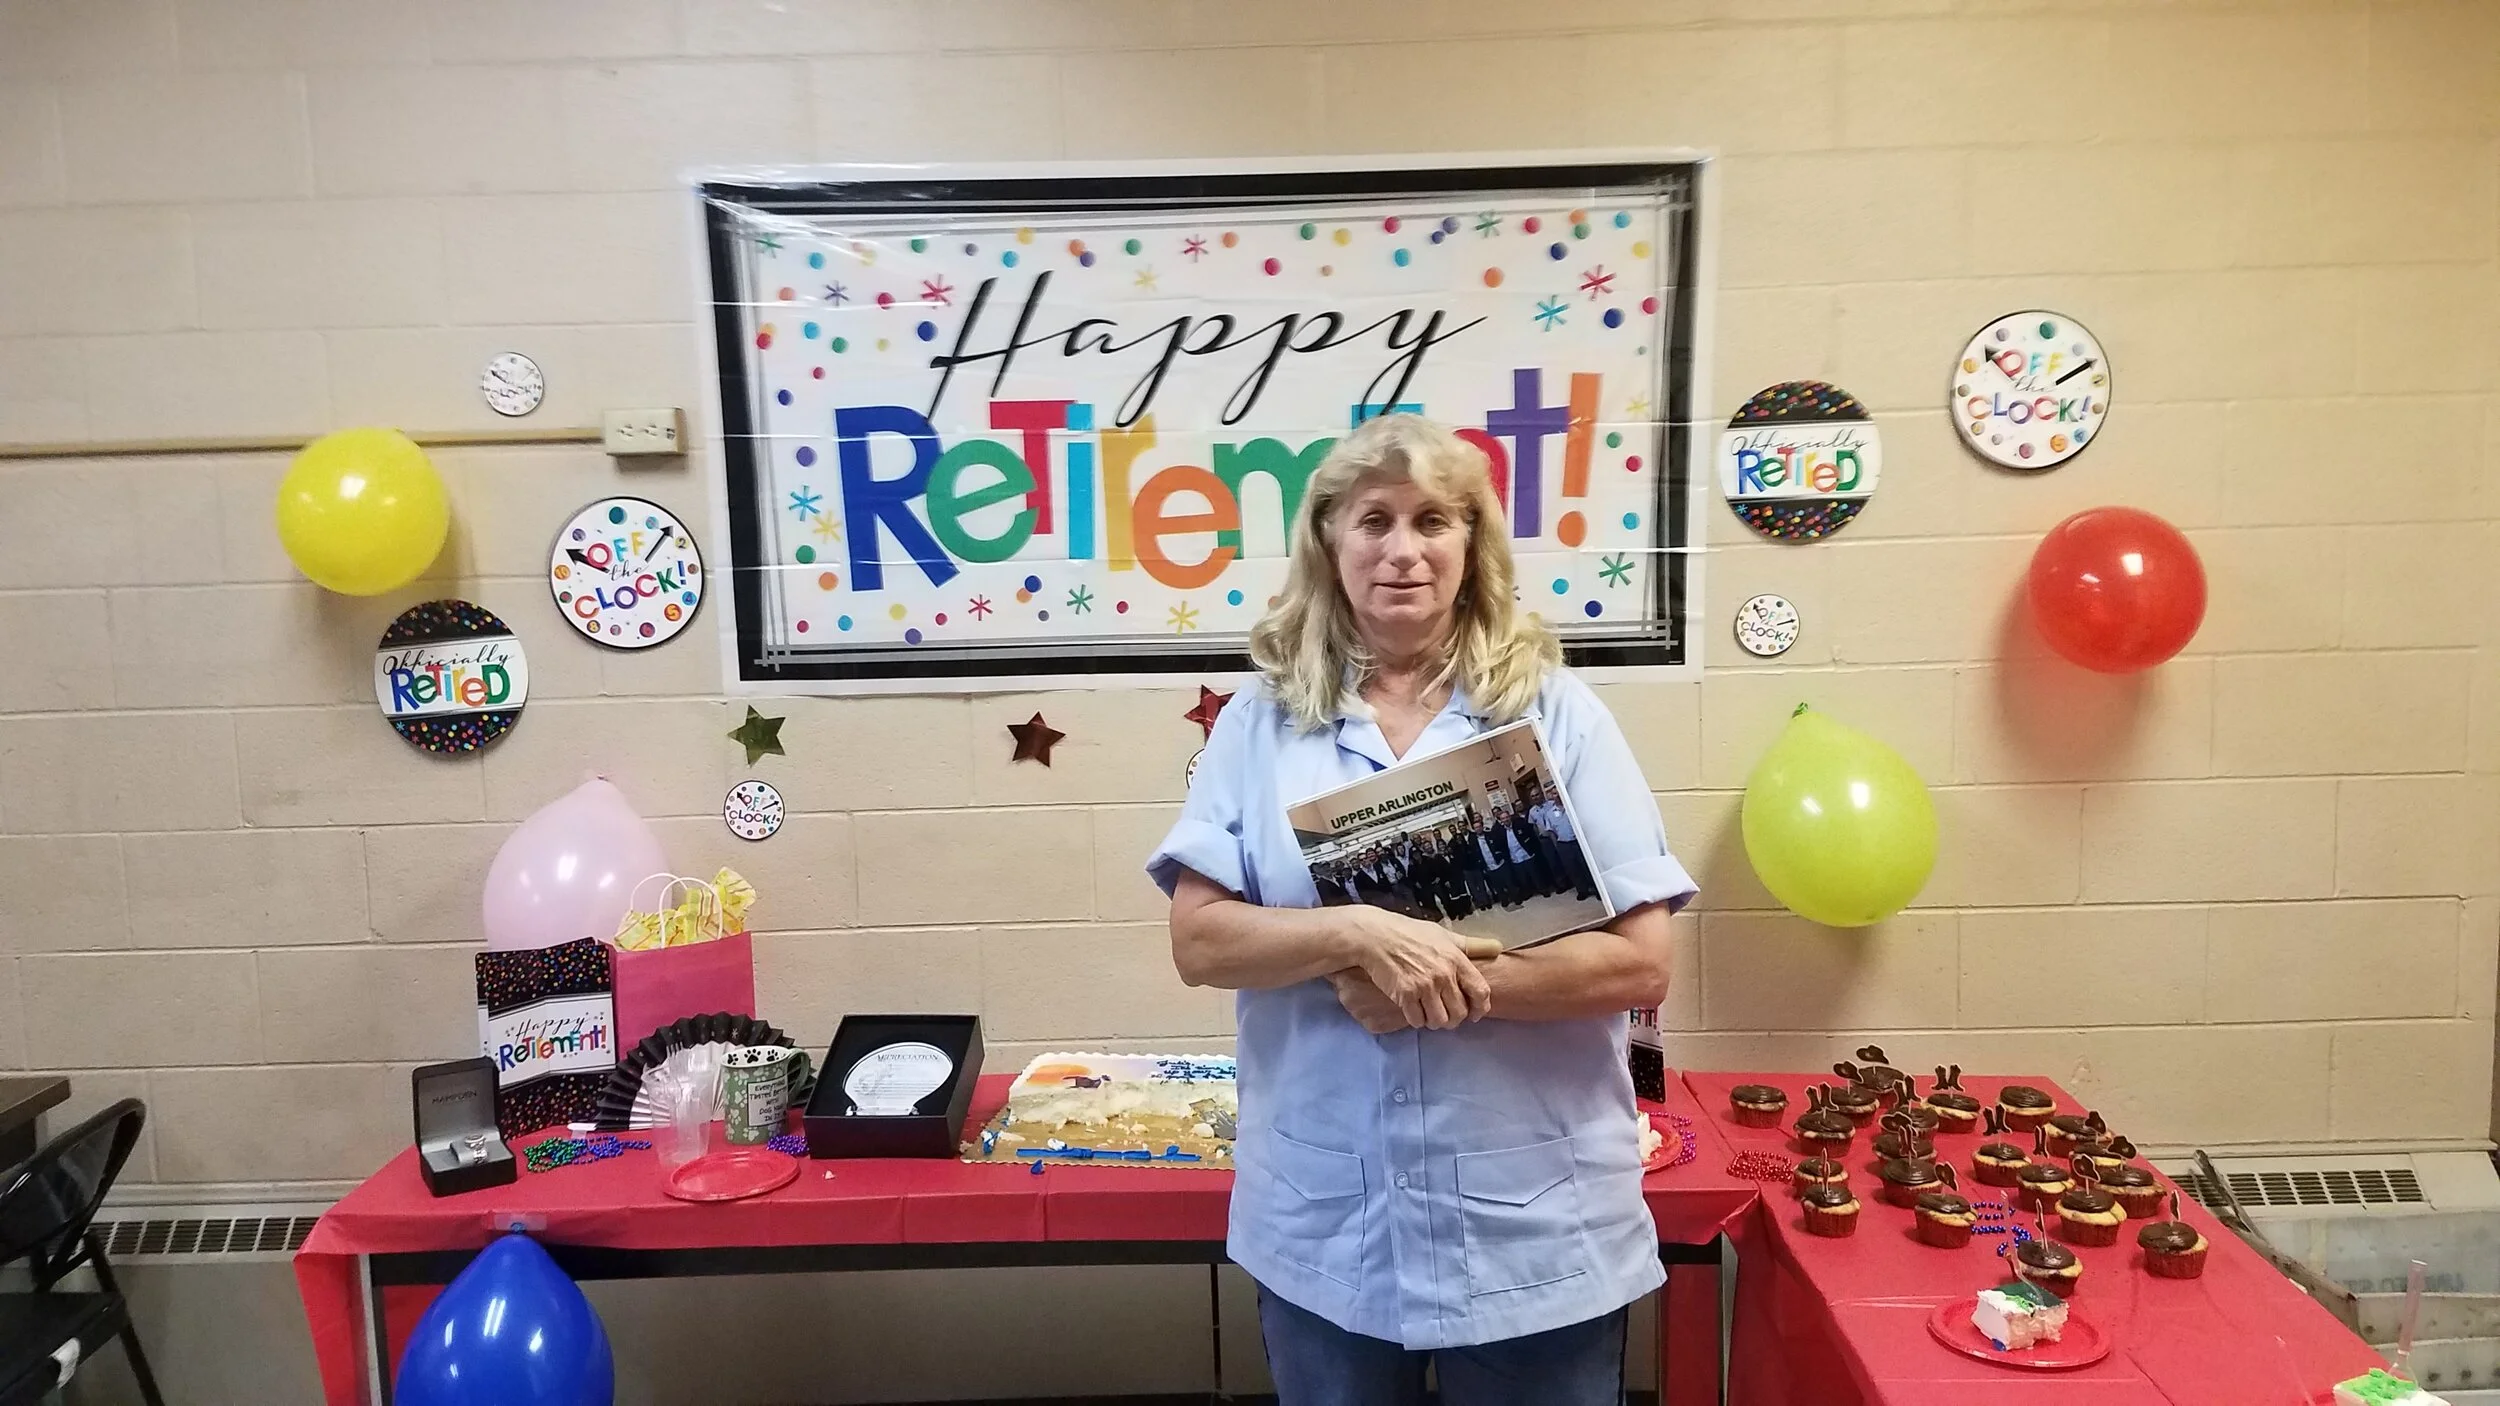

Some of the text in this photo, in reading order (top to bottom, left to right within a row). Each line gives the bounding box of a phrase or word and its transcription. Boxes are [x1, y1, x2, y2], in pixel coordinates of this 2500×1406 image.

[928, 269, 1489, 428] Happy
[2000, 350, 2063, 377] OFF
[1967, 392, 2092, 424] CLOCK!
[587, 531, 645, 569] OFF
[609, 560, 647, 581] the
[574, 560, 687, 618] CLOCK!
[1741, 621, 1789, 641] CLOCK!
[383, 643, 514, 675] Officially
[729, 809, 776, 824] CLOCK!
[1331, 781, 1454, 829] UPPER ARLINGTON
[515, 1018, 590, 1045] Happy
